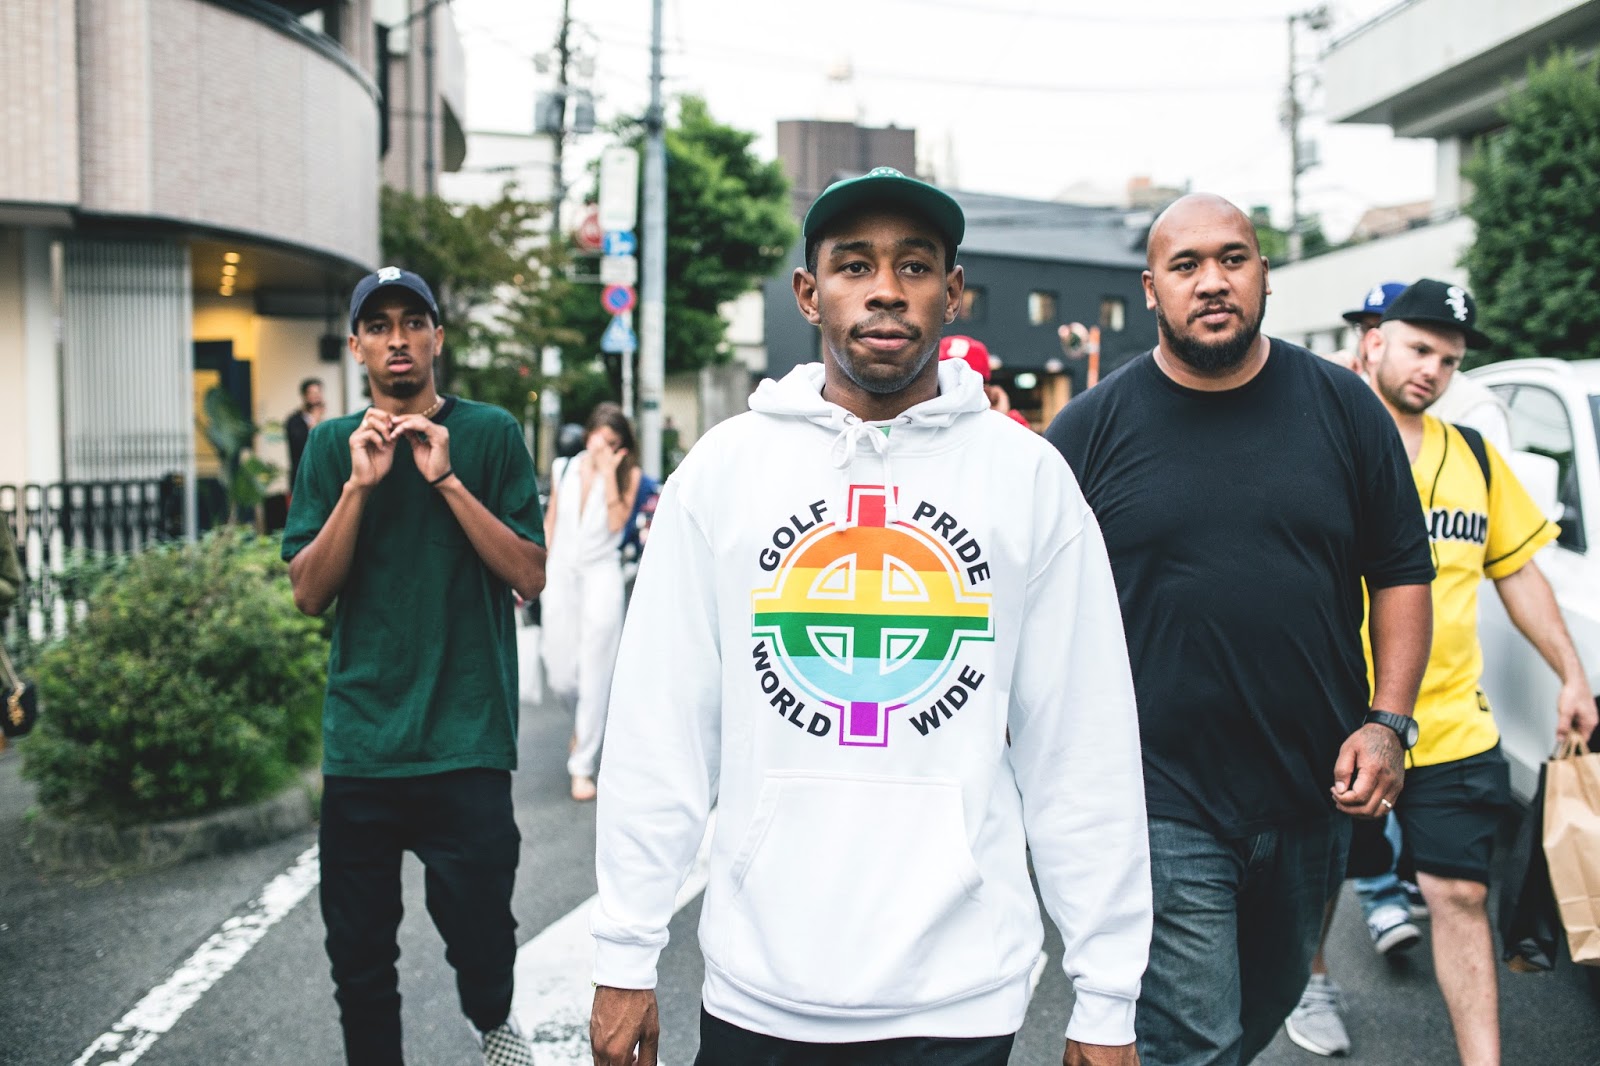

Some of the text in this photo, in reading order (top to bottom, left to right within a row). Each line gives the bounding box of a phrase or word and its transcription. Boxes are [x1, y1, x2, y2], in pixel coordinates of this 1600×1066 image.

[759, 499, 991, 586] GOLF PRIDE
[752, 640, 985, 737] WORLD WIDE
